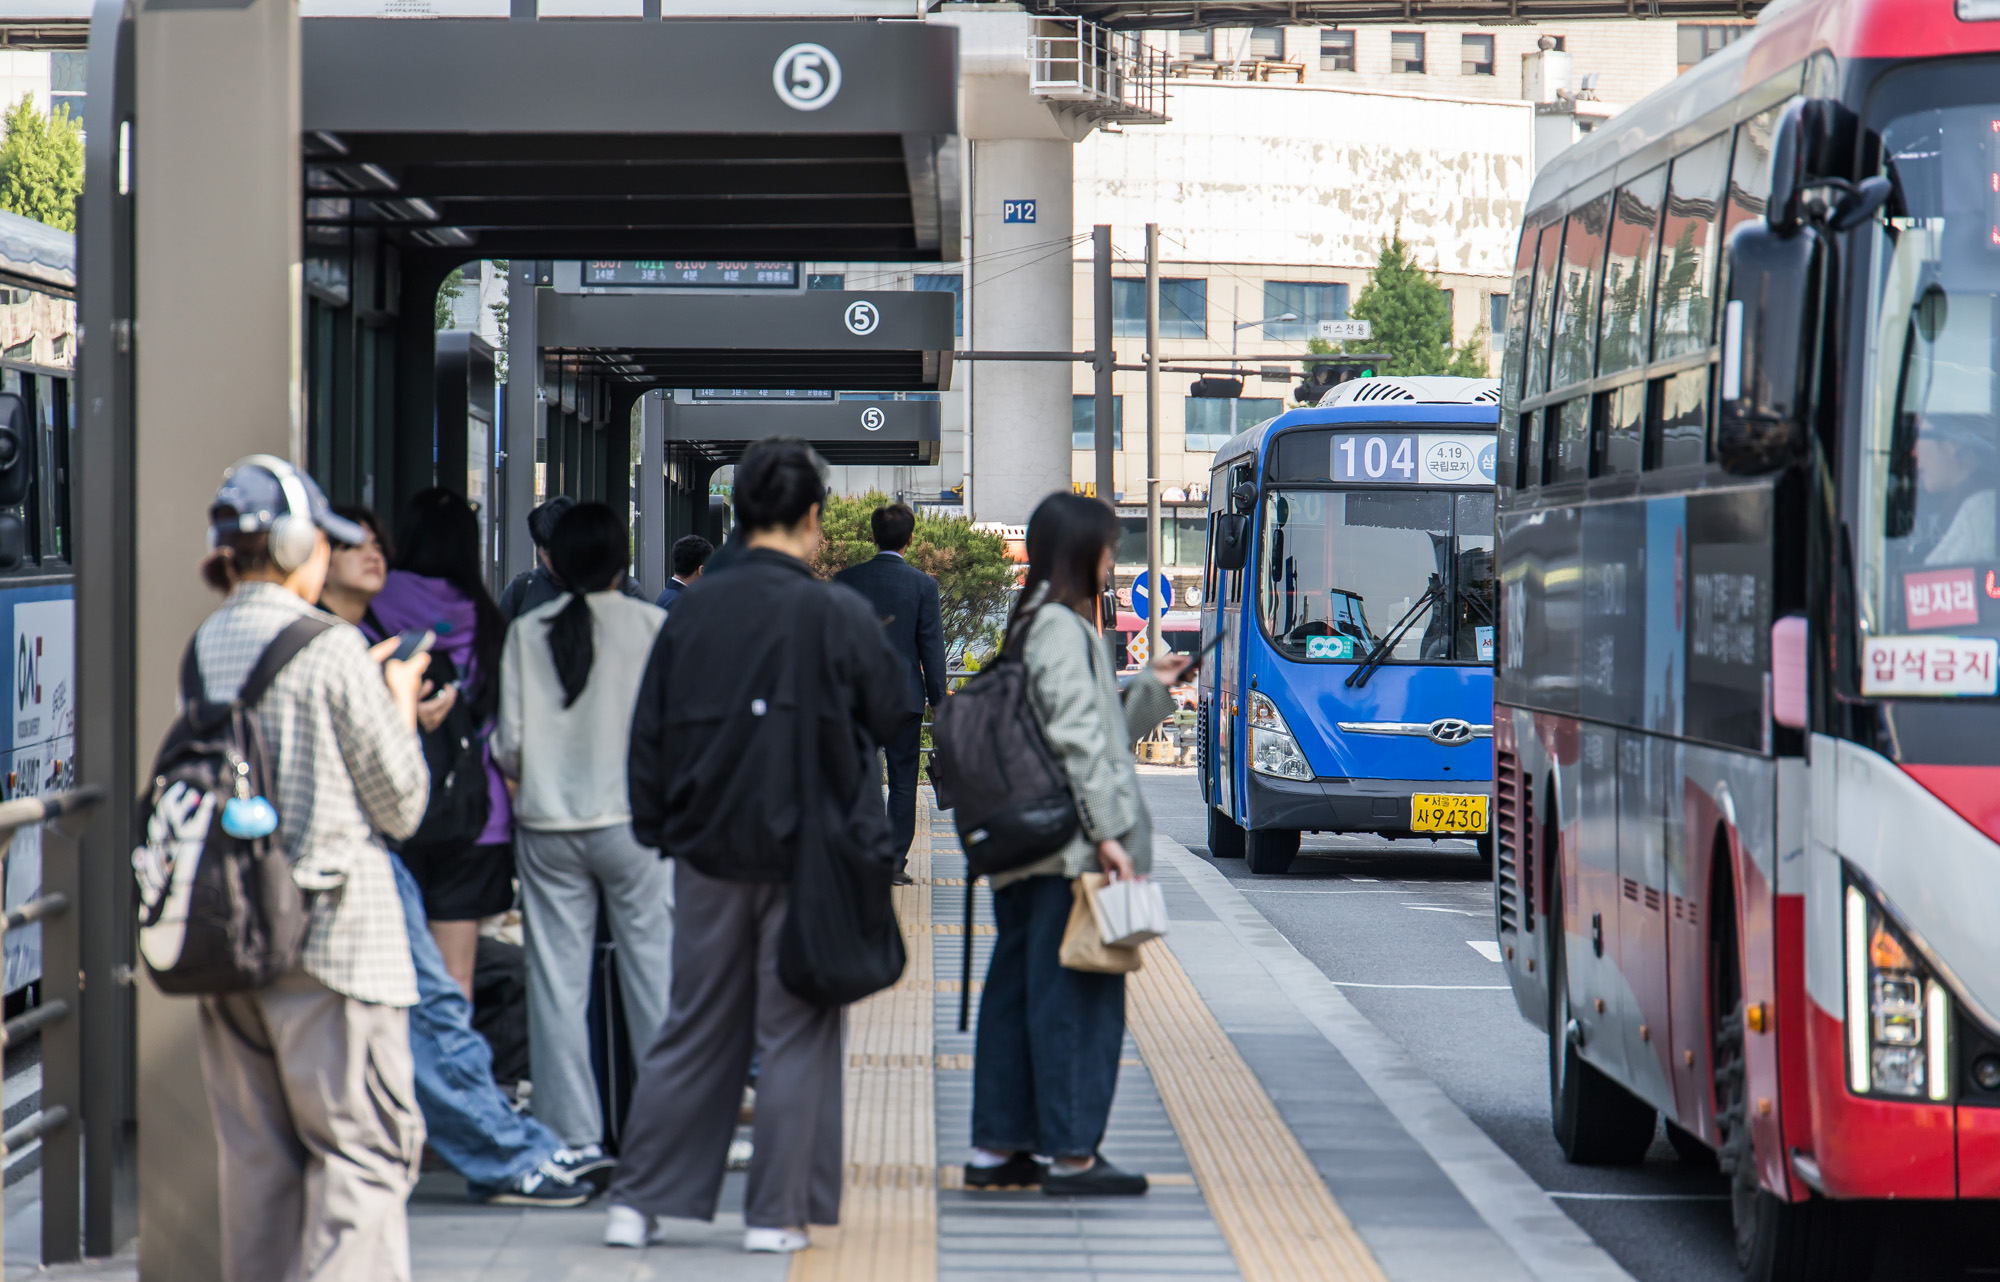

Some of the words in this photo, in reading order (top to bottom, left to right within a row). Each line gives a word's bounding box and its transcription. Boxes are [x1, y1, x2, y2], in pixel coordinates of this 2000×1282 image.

[1004, 202, 1035, 220] P12
[1322, 323, 1365, 336] 버스전용
[1339, 436, 1415, 478] 104
[1436, 447, 1463, 459] 4.19
[1429, 461, 1470, 473] 국립묘지
[1907, 579, 1975, 617] 빈자리
[1871, 648, 1990, 683] 입석금지
[1431, 796, 1450, 807] 서울
[1452, 797, 1468, 808] 74
